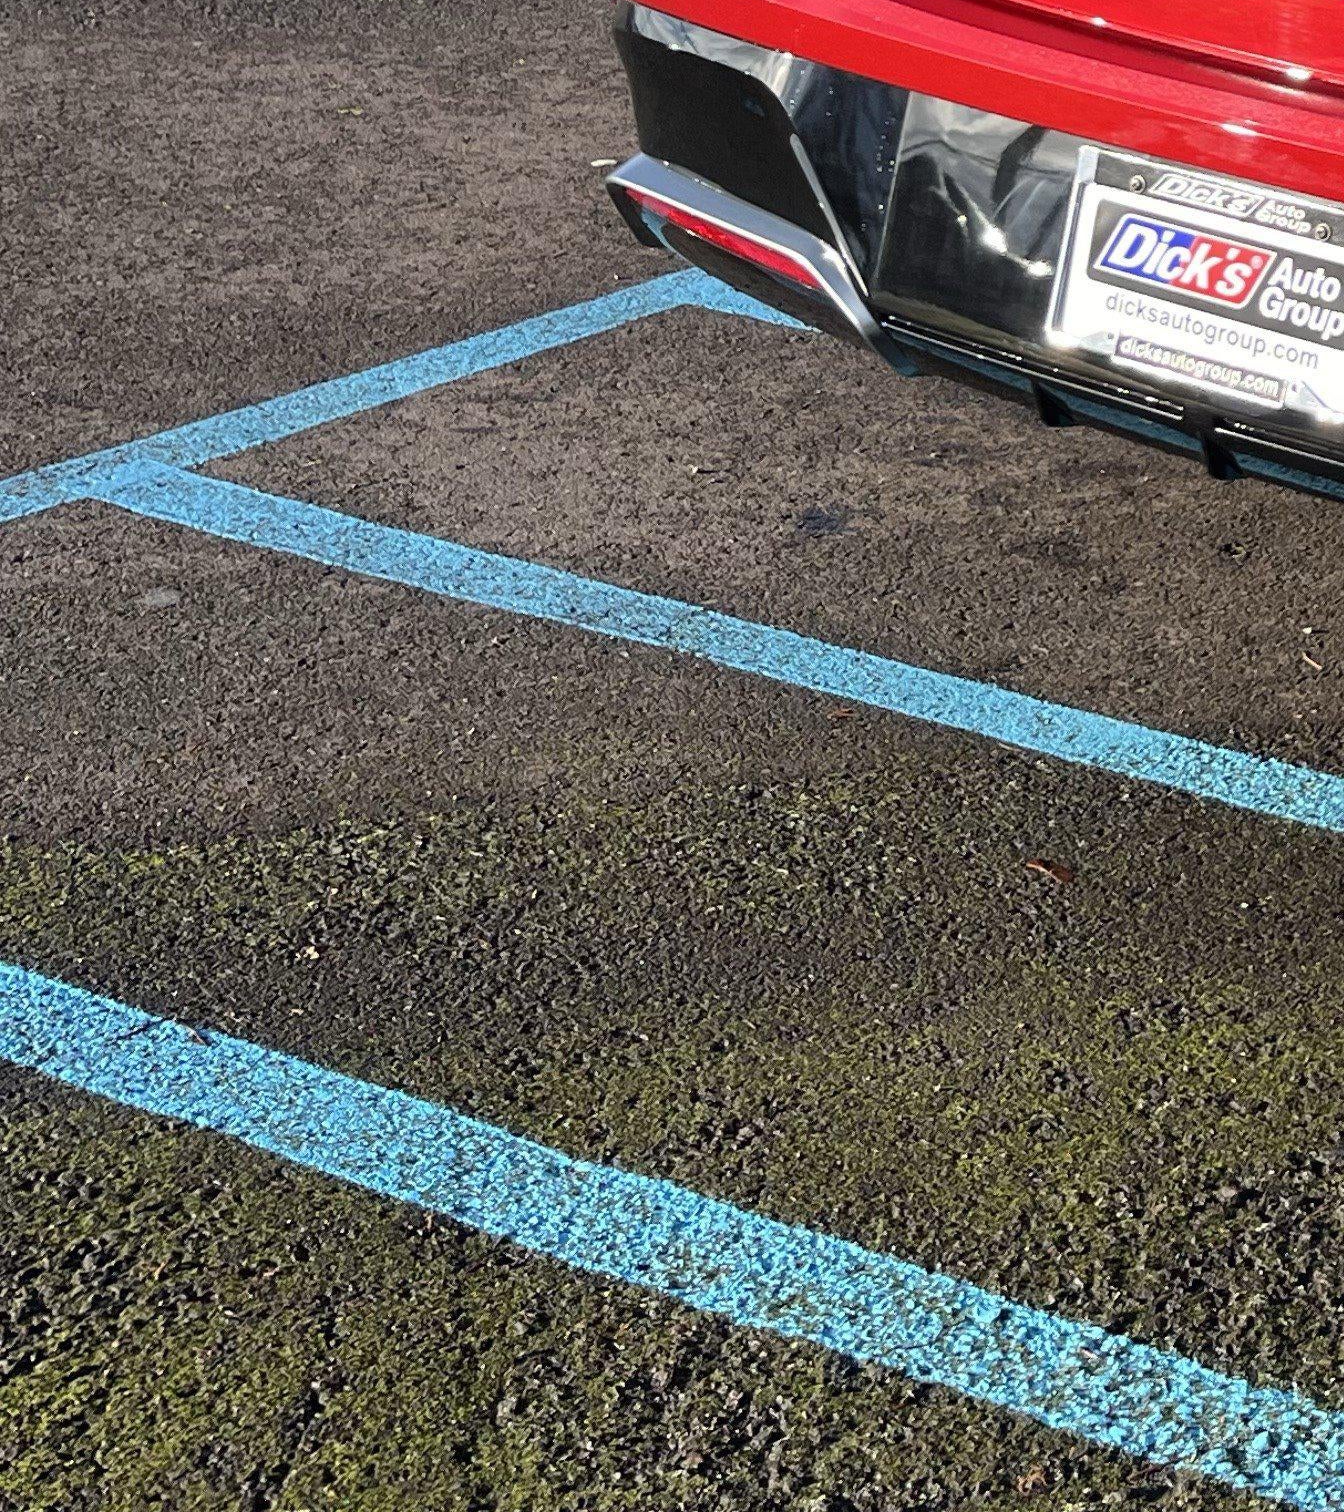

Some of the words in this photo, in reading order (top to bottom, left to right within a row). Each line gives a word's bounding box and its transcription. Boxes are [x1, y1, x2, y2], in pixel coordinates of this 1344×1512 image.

[1254, 210, 1312, 235] Group
[1262, 200, 1307, 220] Auto
[1107, 223, 1253, 297] Dick's
[1267, 256, 1342, 302] Auto
[1104, 292, 1320, 370] dicksautogroup.com
[1120, 337, 1280, 399] dicksautogroup.com
